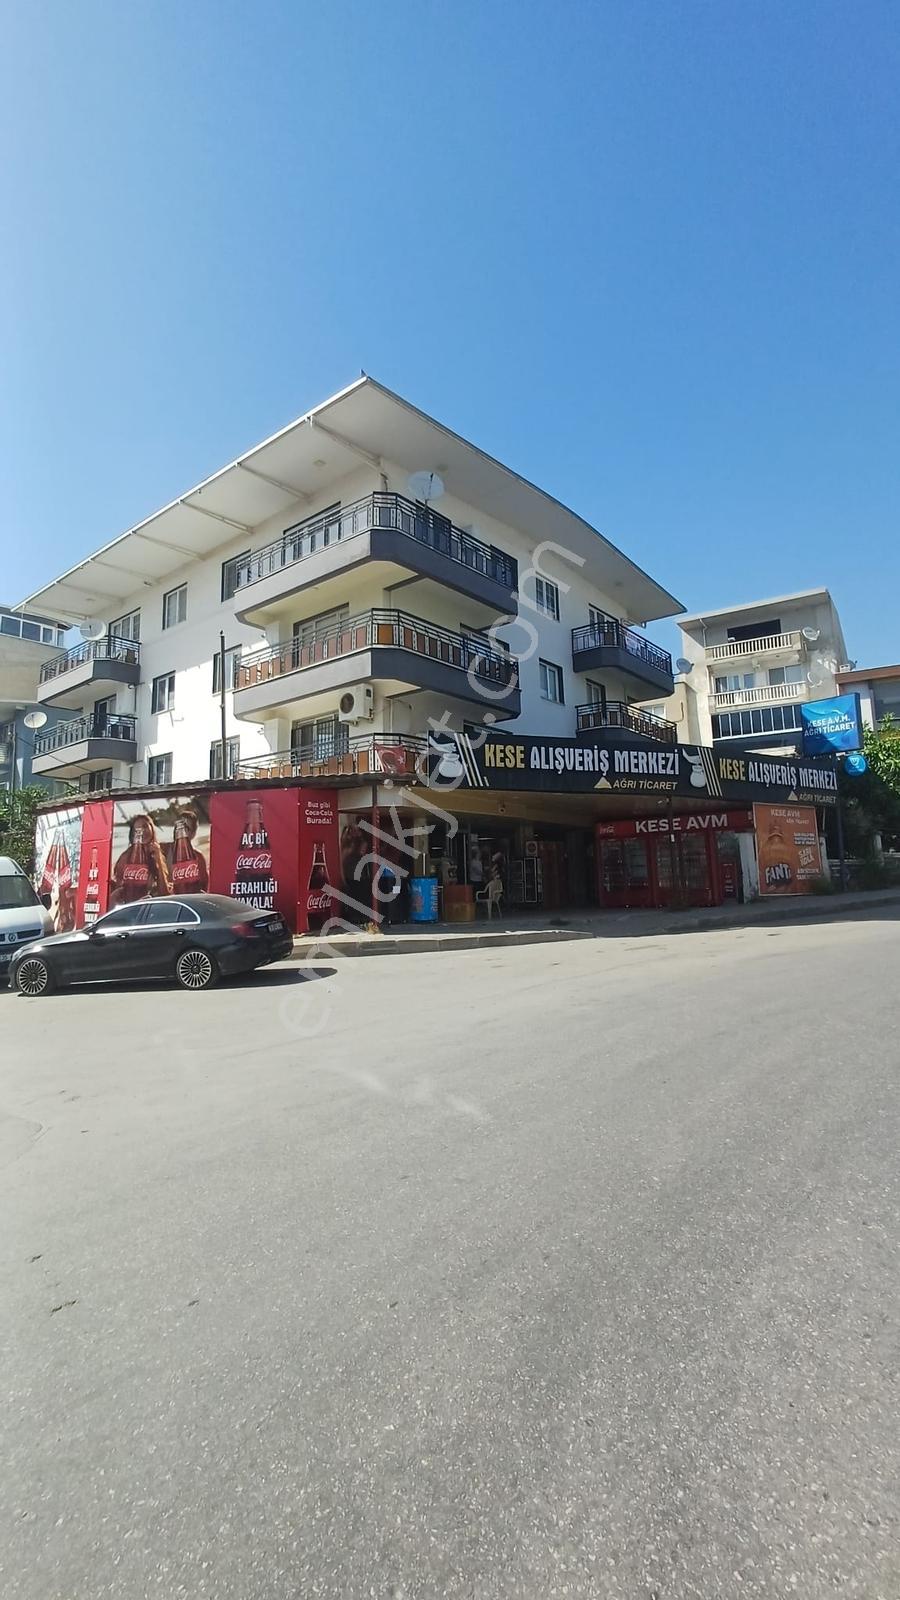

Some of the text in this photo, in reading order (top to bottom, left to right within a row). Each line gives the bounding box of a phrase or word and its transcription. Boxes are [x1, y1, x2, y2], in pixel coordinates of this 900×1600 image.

[822, 722, 855, 734] TİCARET
[484, 743, 680, 776] KESE ALIŞVERİŞ MERKEZİ
[719, 758, 838, 791] KESE ALIŞVERİŞ MERKEZİ
[613, 777, 678, 791] AĞRI TİCARET
[306, 816, 332, 825] Burada!
[635, 817, 682, 834] KESE
[686, 813, 728, 830] AVM
[242, 832, 255, 848] AÇ
[236, 853, 272, 870] Coca-Cola
[172, 863, 200, 881] Coca-Cola
[230, 878, 278, 895] FERAHLIĞI
